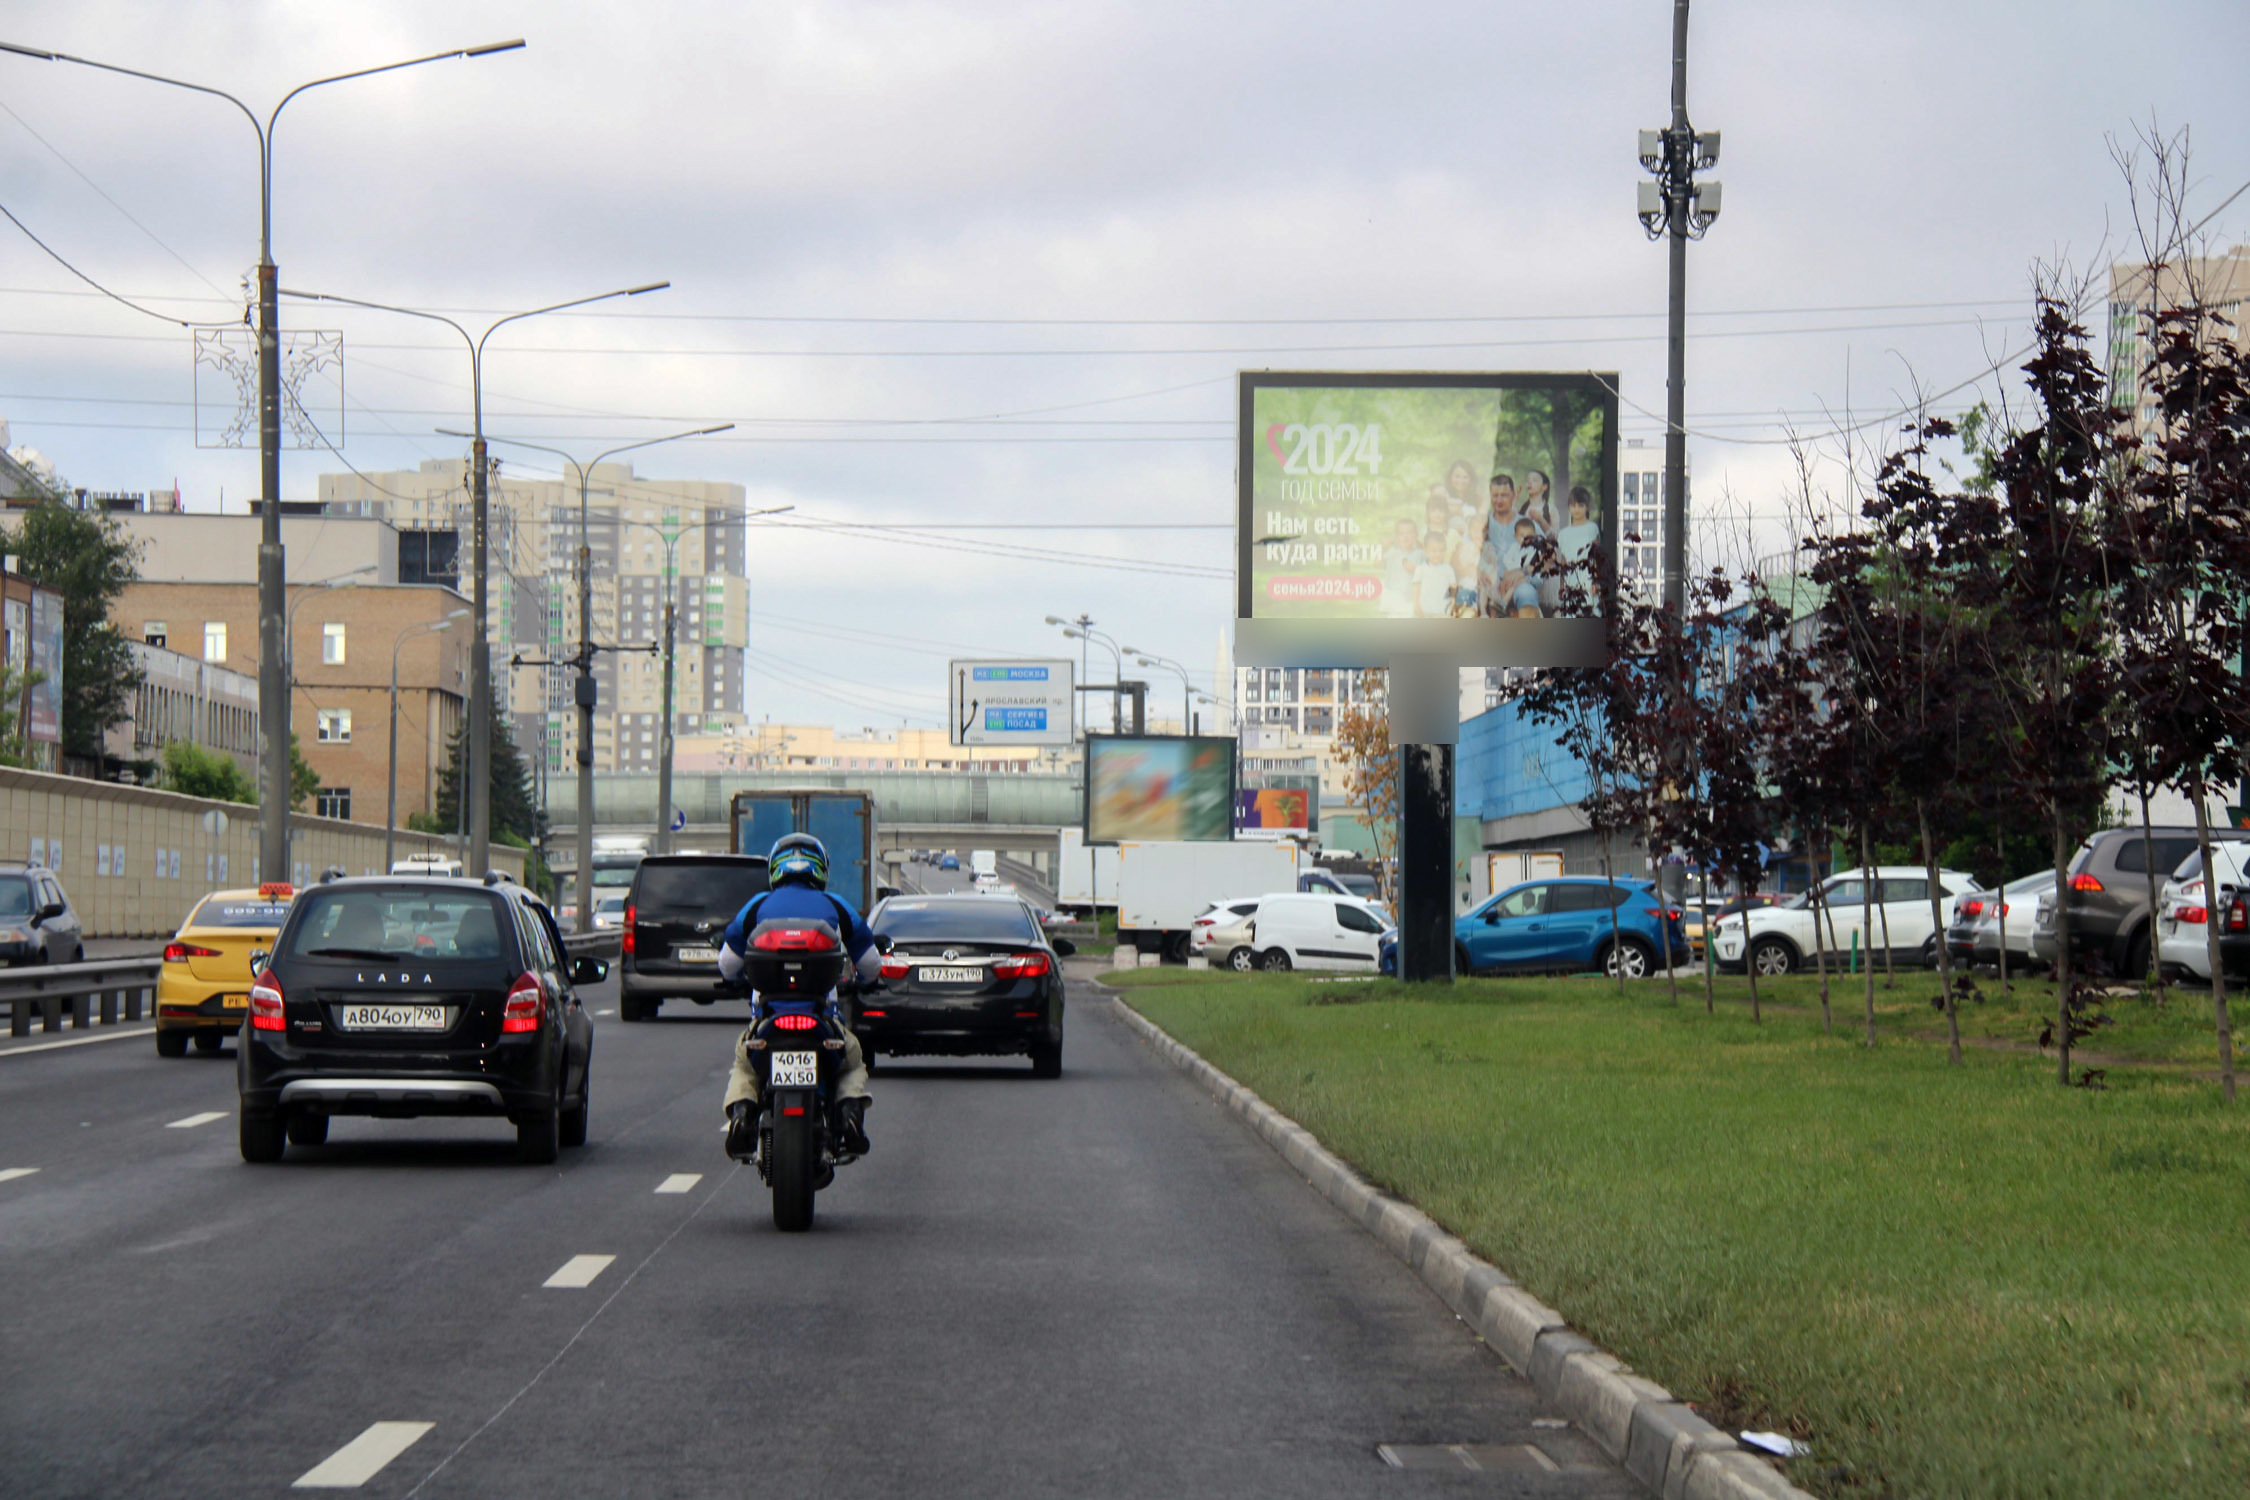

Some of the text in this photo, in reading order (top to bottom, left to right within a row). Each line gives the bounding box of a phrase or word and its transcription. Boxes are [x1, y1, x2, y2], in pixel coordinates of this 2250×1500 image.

[1283, 423, 1383, 475] 2024
[1266, 511, 1361, 536] Нам есть
[1266, 543, 1382, 567] куда расти
[1273, 579, 1376, 598] семья2024.рф
[1010, 670, 1047, 678] МОСКВА
[1007, 720, 1037, 729] ПОСАД
[357, 972, 432, 983] LADA
[348, 1007, 441, 1025] А804ОУ 790
[778, 1053, 811, 1065] 4016
[774, 1071, 814, 1084] АХ 50
